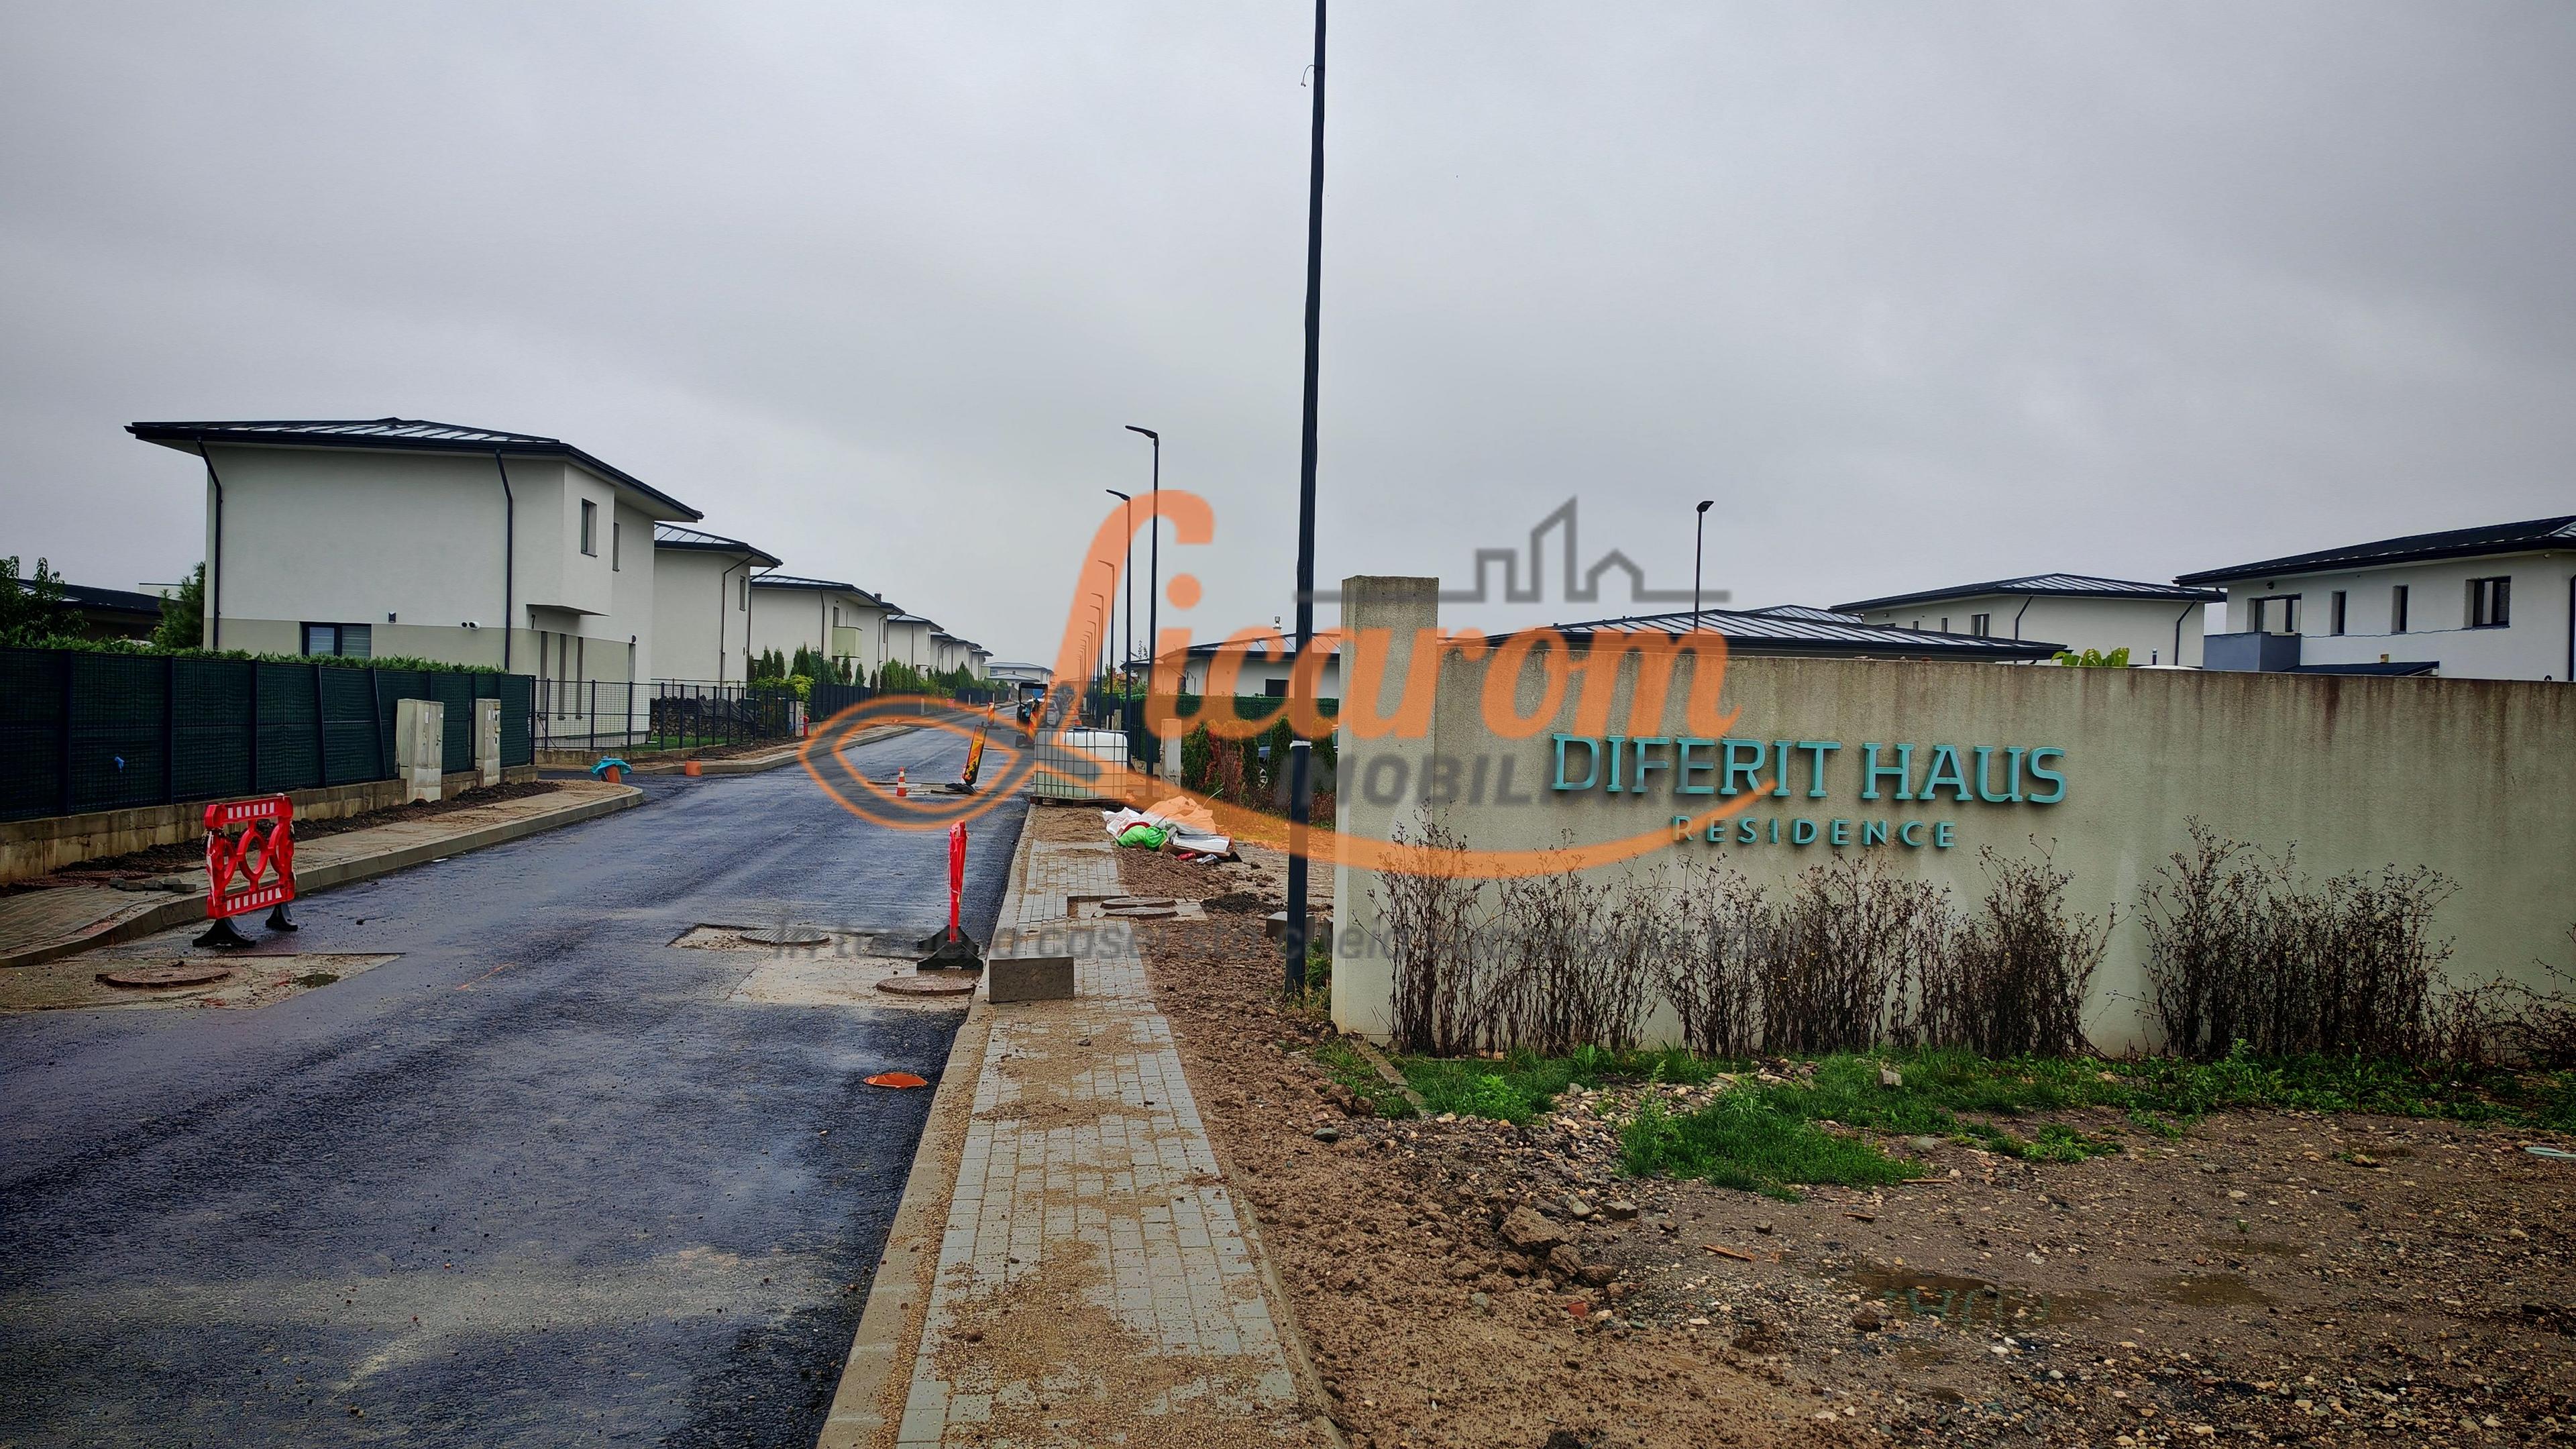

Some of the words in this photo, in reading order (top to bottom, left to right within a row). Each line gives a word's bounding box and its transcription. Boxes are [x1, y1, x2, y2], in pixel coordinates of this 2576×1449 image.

[1551, 733, 1843, 799] DIFERIT
[1861, 741, 2068, 804] HAUS
[1671, 814, 1956, 848] RESIDENCE
